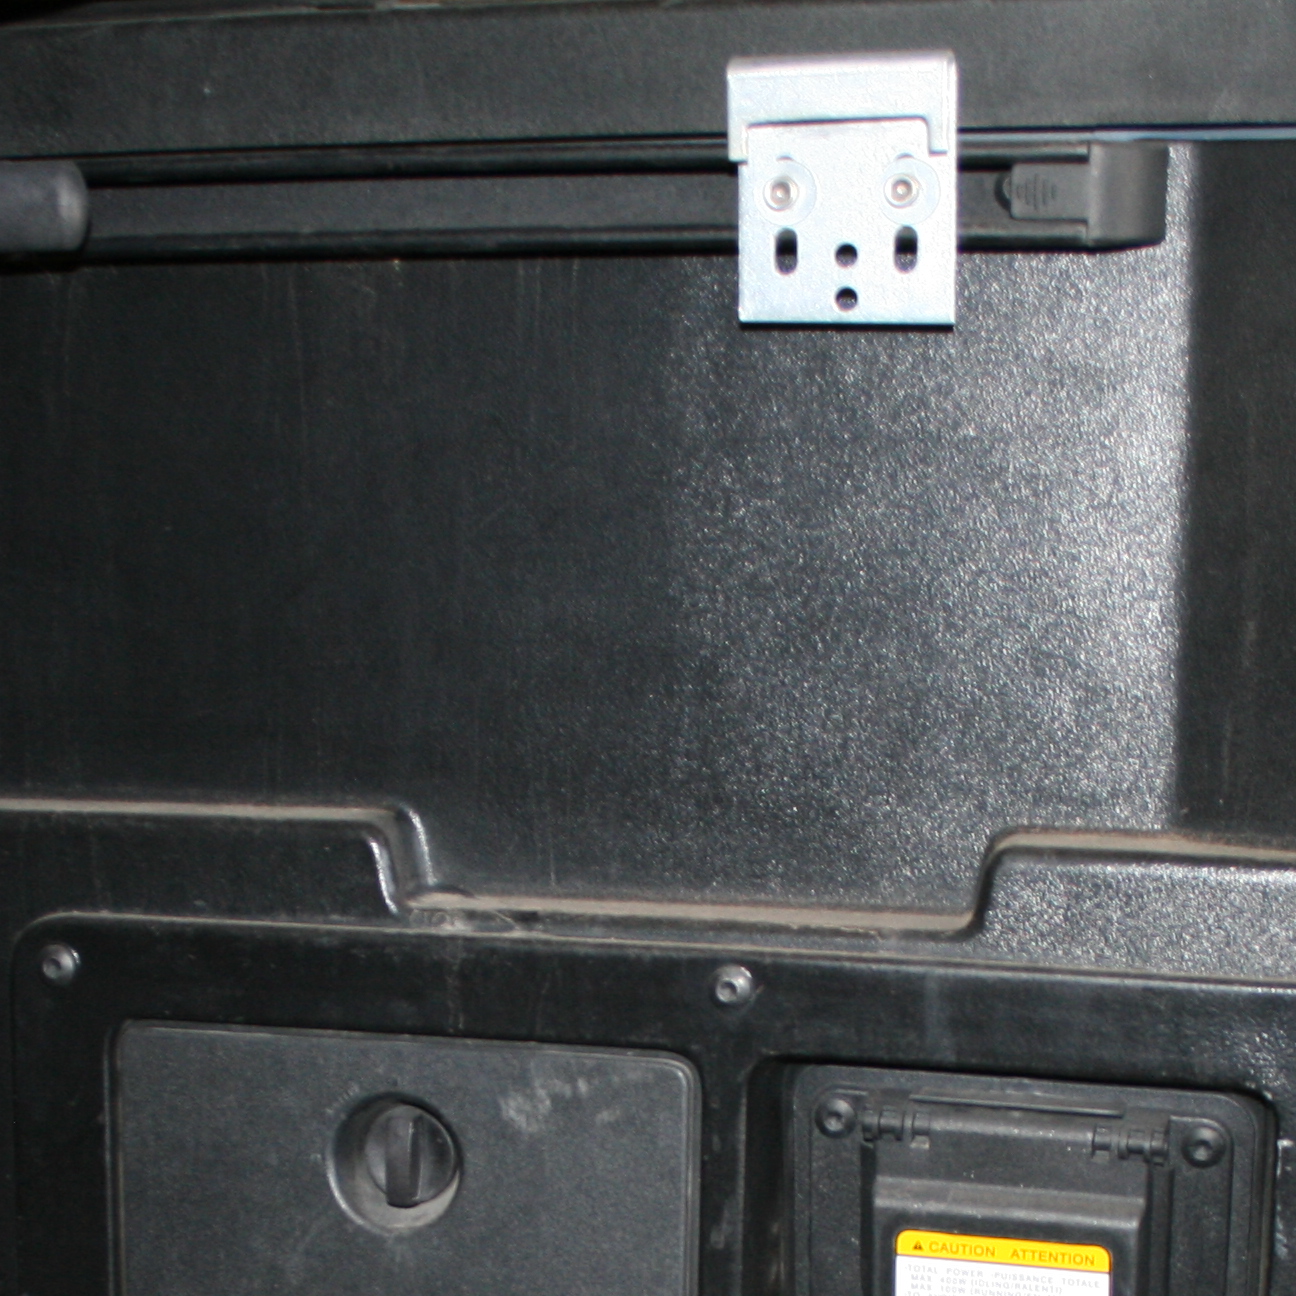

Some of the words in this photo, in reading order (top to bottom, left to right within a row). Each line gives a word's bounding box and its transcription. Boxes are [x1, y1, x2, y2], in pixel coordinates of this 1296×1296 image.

[929, 1241, 995, 1258] CAUTION
[1010, 1247, 1095, 1266] ATTENTION
[946, 1268, 983, 1278] POWER
[1061, 1277, 1099, 1287] TOTALE
